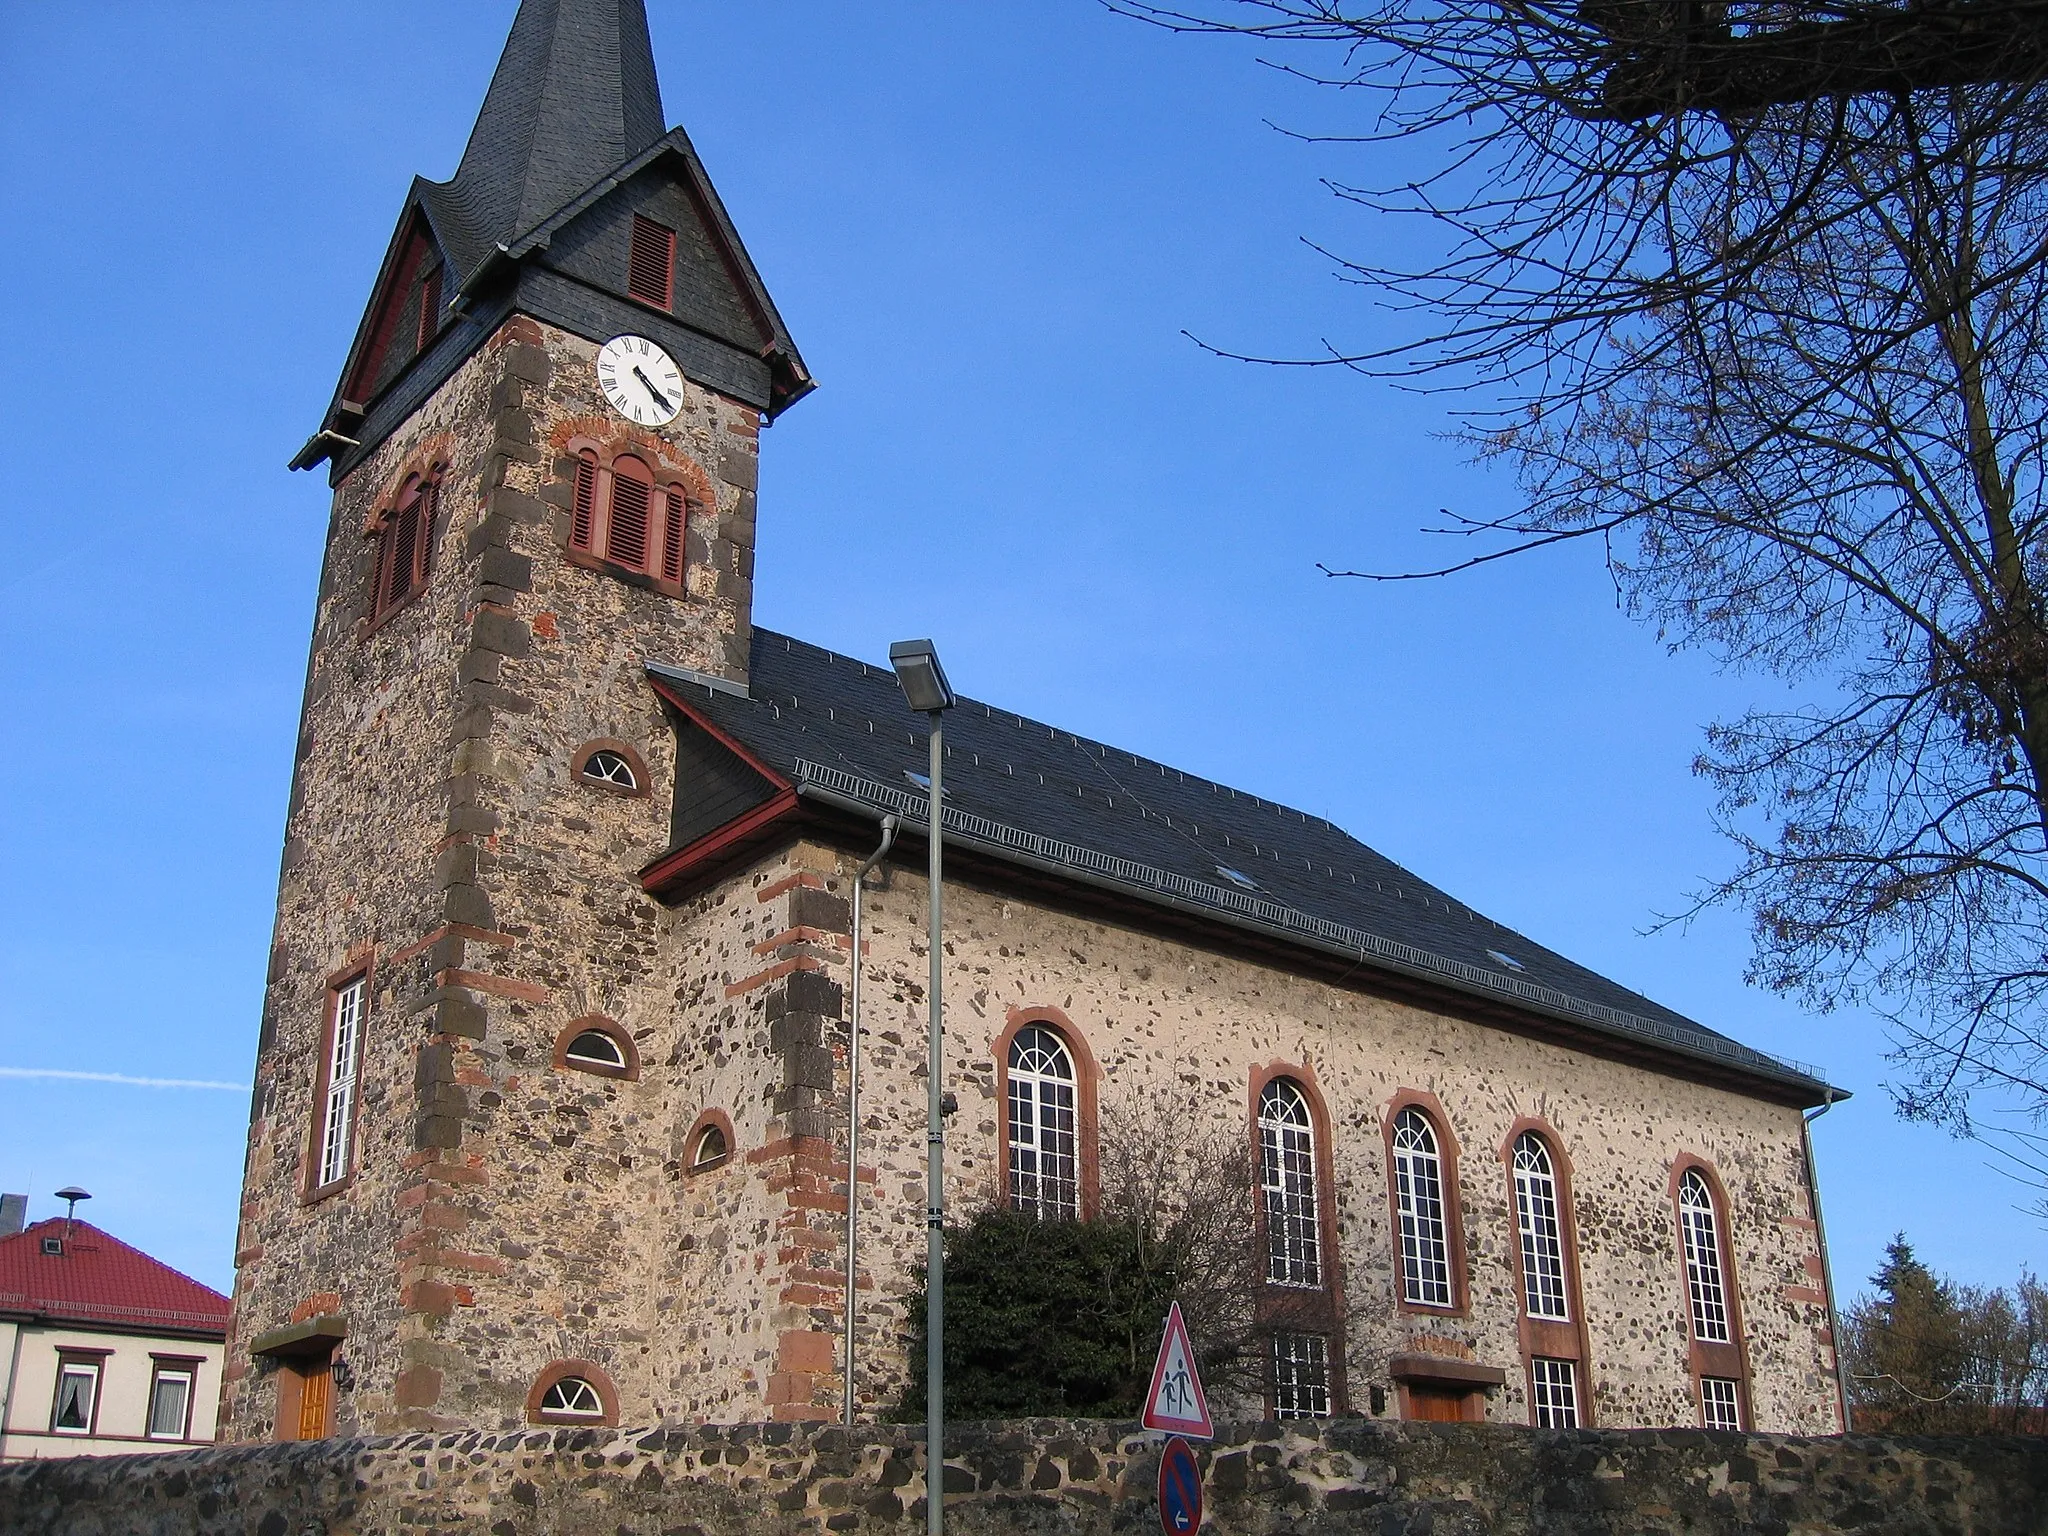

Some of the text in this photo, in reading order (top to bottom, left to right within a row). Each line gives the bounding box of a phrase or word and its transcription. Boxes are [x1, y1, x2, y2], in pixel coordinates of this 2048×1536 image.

[606, 344, 621, 360] X
[638, 339, 650, 357] XII
[602, 378, 619, 393] VIII
[614, 394, 628, 411] VII
[634, 405, 642, 422] VI
[652, 408, 661, 424] V
